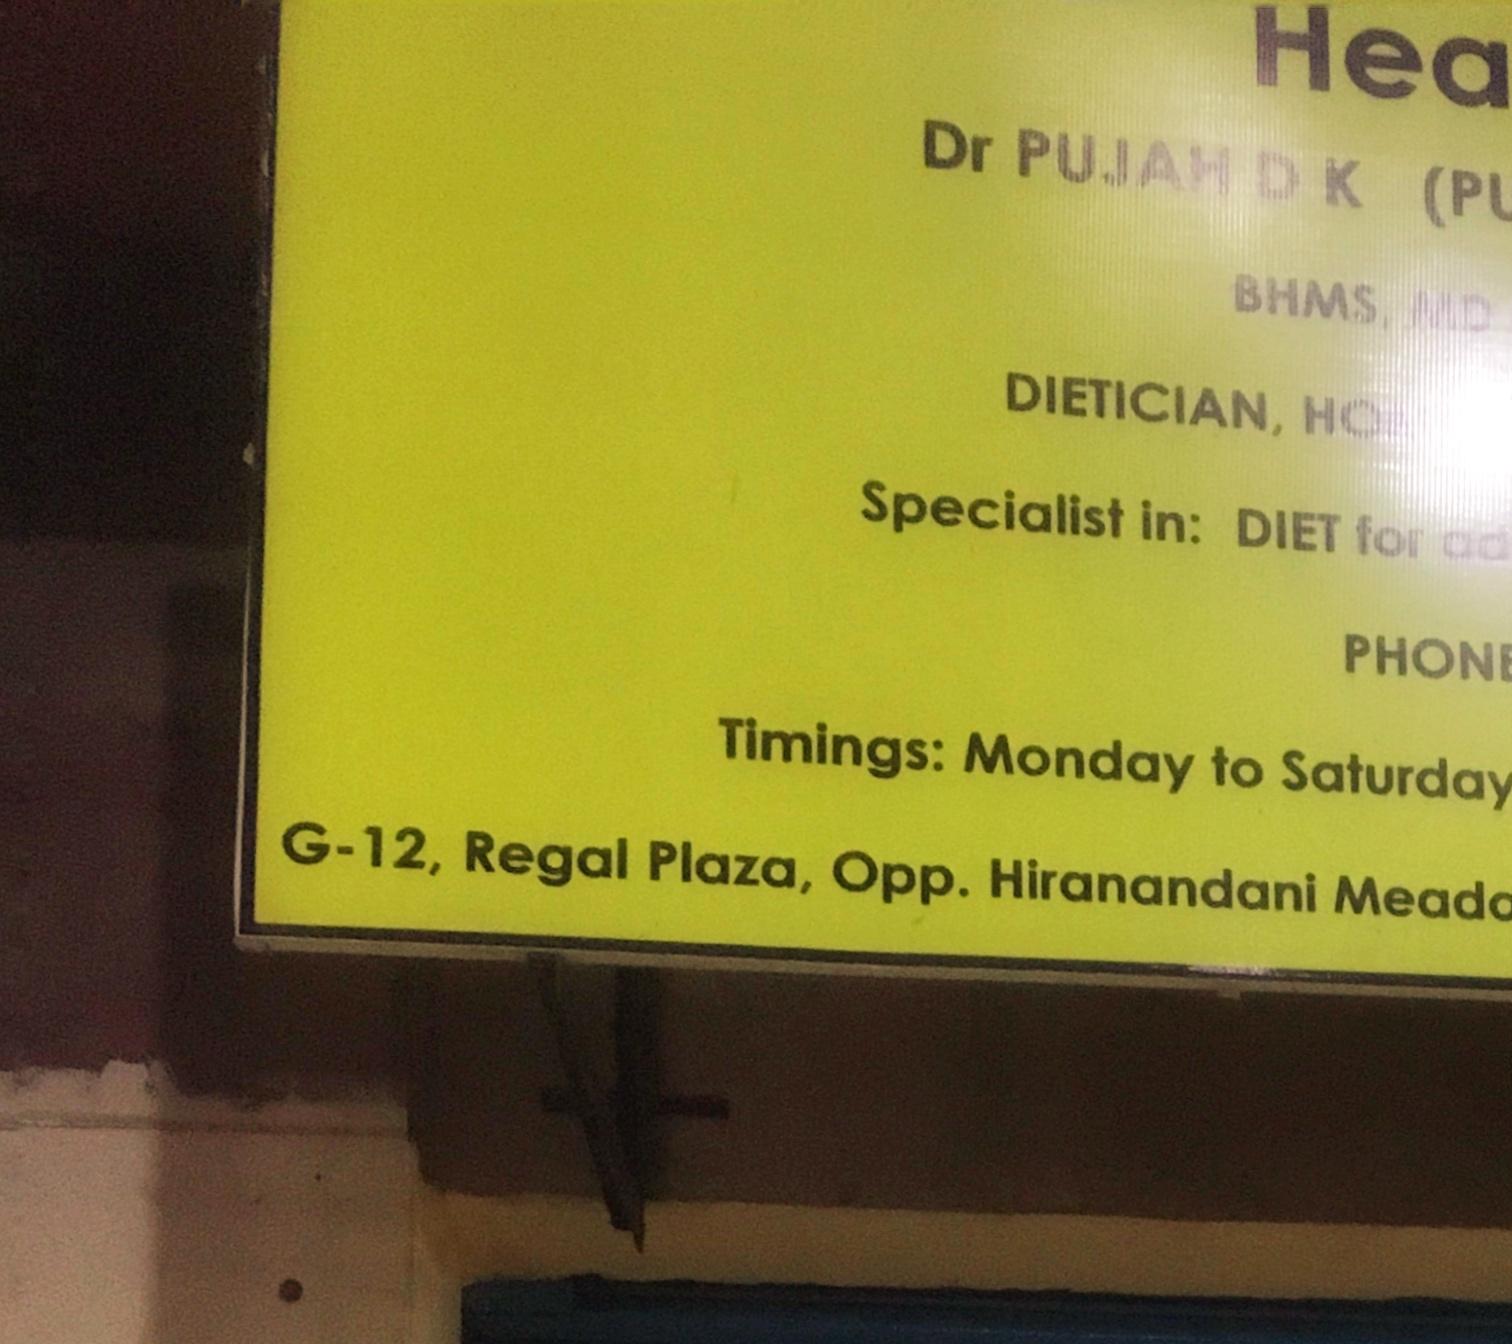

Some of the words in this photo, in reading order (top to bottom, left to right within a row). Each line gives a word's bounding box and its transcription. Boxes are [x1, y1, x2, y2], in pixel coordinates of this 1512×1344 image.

[924, 119, 993, 173] Dr
[1017, 128, 1230, 198] PUJAH
[1257, 149, 1299, 200] D
[1324, 158, 1364, 208] K
[1233, 274, 1390, 331] BHMS,
[1005, 371, 1284, 438] DIETICIAN,
[861, 480, 1124, 539] Specialist
[1141, 499, 1202, 544] in:
[1237, 507, 1341, 553] DIET
[1356, 514, 1425, 559] for
[717, 717, 946, 779] Timings:
[962, 730, 1195, 794] Monday
[1210, 745, 1264, 791] to
[280, 819, 443, 878] G-12,
[465, 830, 629, 888] Regal
[648, 840, 814, 896] Plaza,
[832, 849, 971, 905] Opp.
[989, 857, 1318, 914] Hiranandani
